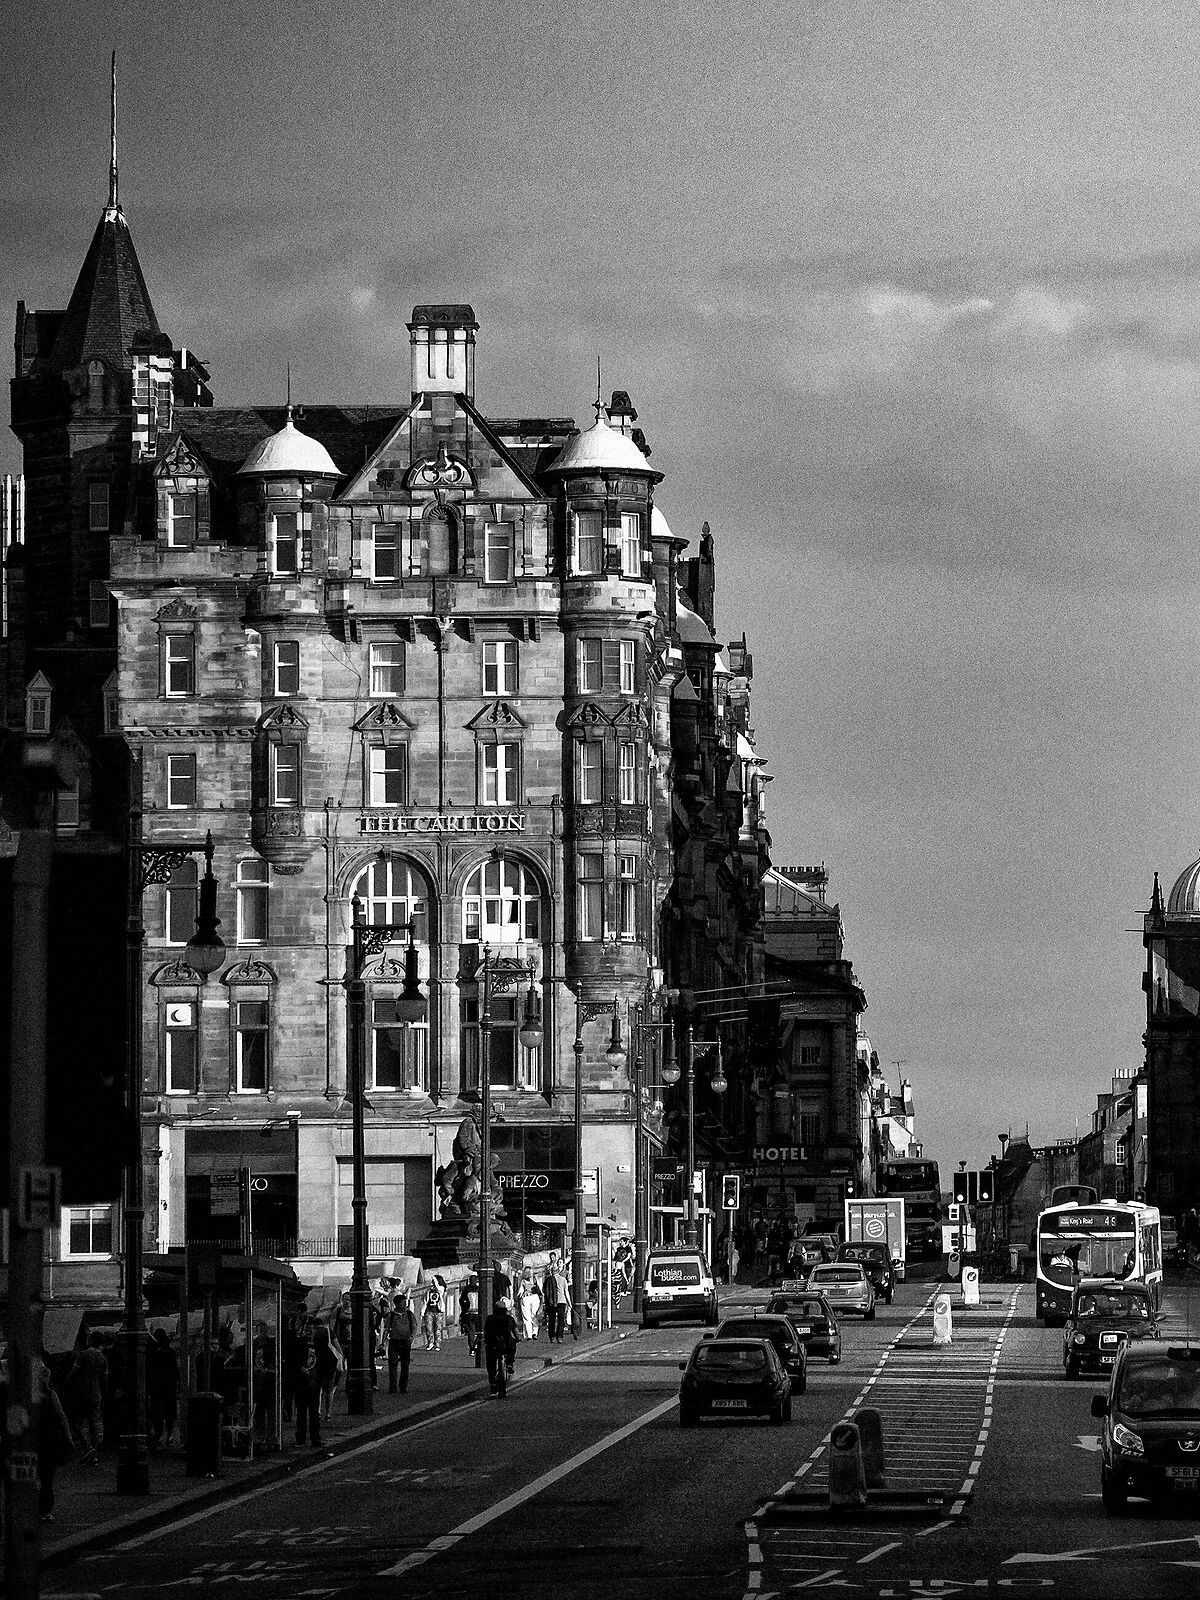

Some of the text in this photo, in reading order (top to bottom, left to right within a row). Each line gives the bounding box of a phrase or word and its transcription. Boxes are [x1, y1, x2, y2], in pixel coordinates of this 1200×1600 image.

[358, 815, 526, 832] THE CARLTON
[752, 1147, 808, 1160] HOTEL
[499, 1174, 550, 1189] PREZZO
[654, 1268, 682, 1277] Lothian
[661, 1274, 698, 1282] buses.com
[1120, 1447, 1144, 1457] TAXI
